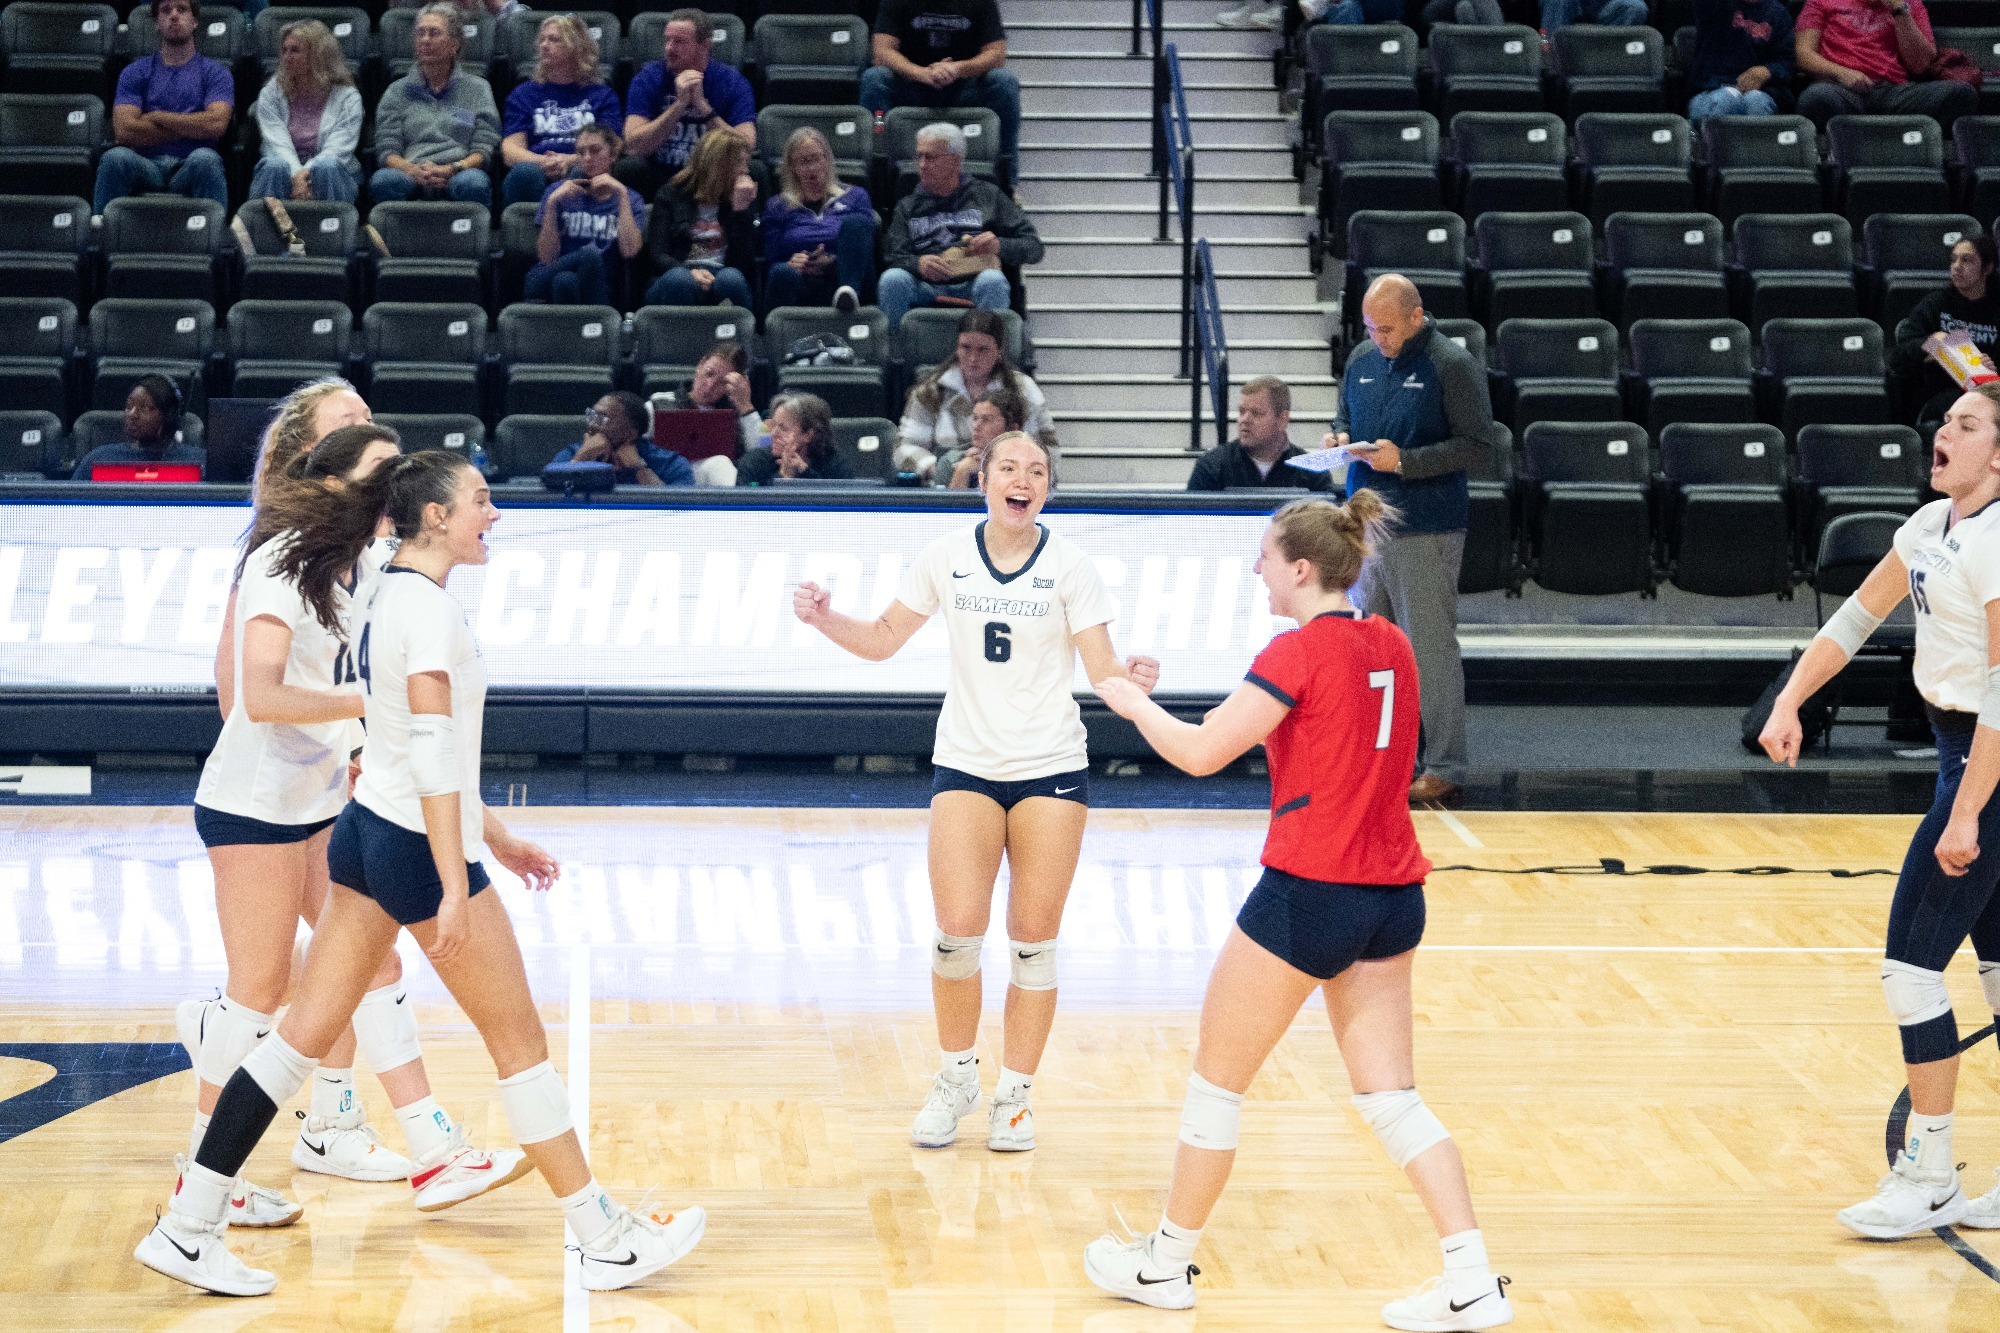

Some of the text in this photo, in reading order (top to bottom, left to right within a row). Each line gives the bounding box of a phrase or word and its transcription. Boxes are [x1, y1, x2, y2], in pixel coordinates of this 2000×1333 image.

[562, 211, 618, 239] URMA
[1940, 320, 1998, 345] ACEMY
[476, 550, 1296, 650] CHAMPIHI
[955, 594, 1050, 617] SAMFORD
[1910, 568, 1931, 615] 15
[358, 621, 371, 695] 4
[984, 620, 1012, 663] 6
[130, 685, 208, 693] DAKTRONICS
[1368, 668, 1395, 750] 7
